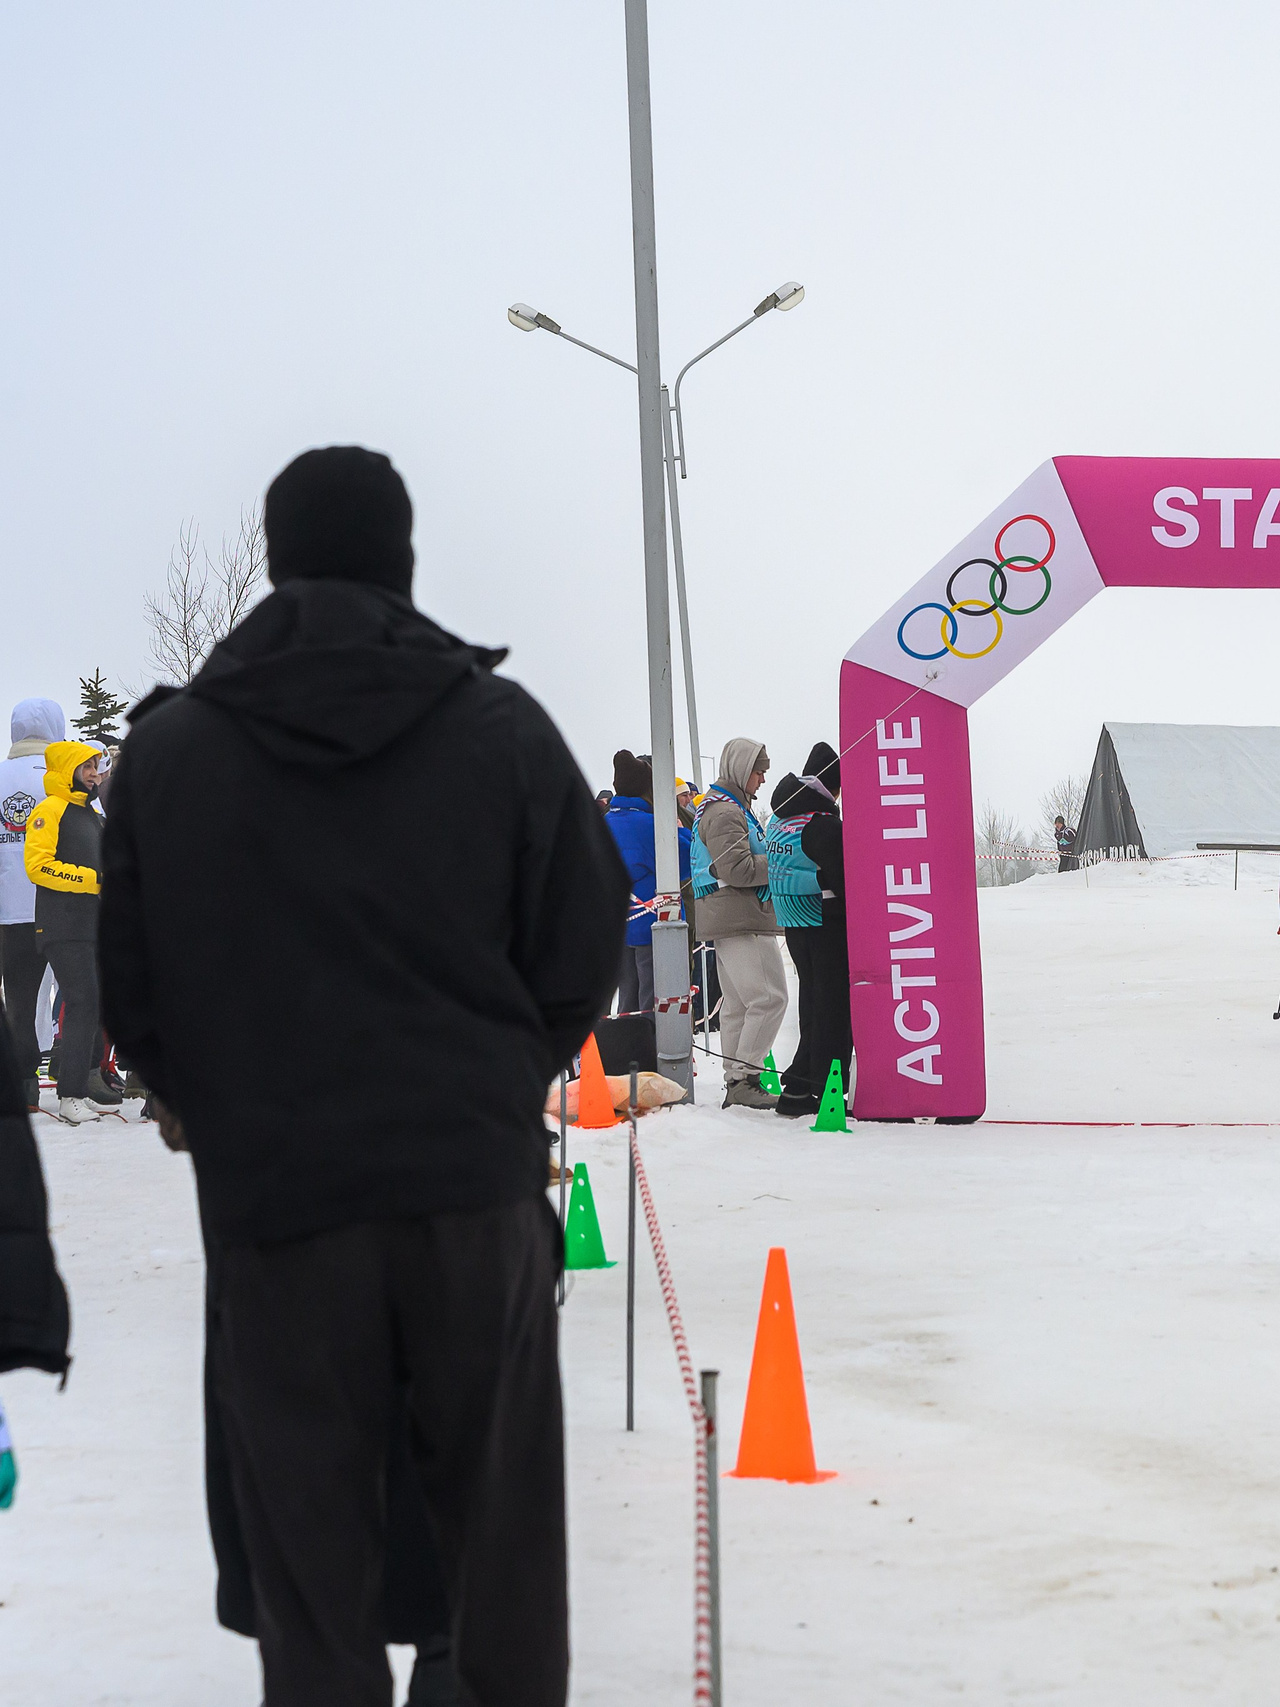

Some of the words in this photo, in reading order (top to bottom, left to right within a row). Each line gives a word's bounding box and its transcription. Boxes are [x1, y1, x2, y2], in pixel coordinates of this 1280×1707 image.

[875, 716, 928, 840] LIFE
[40, 866, 84, 883] BELARUS
[765, 840, 793, 856] УДЬЯ
[884, 862, 943, 1086] ACTIVE
